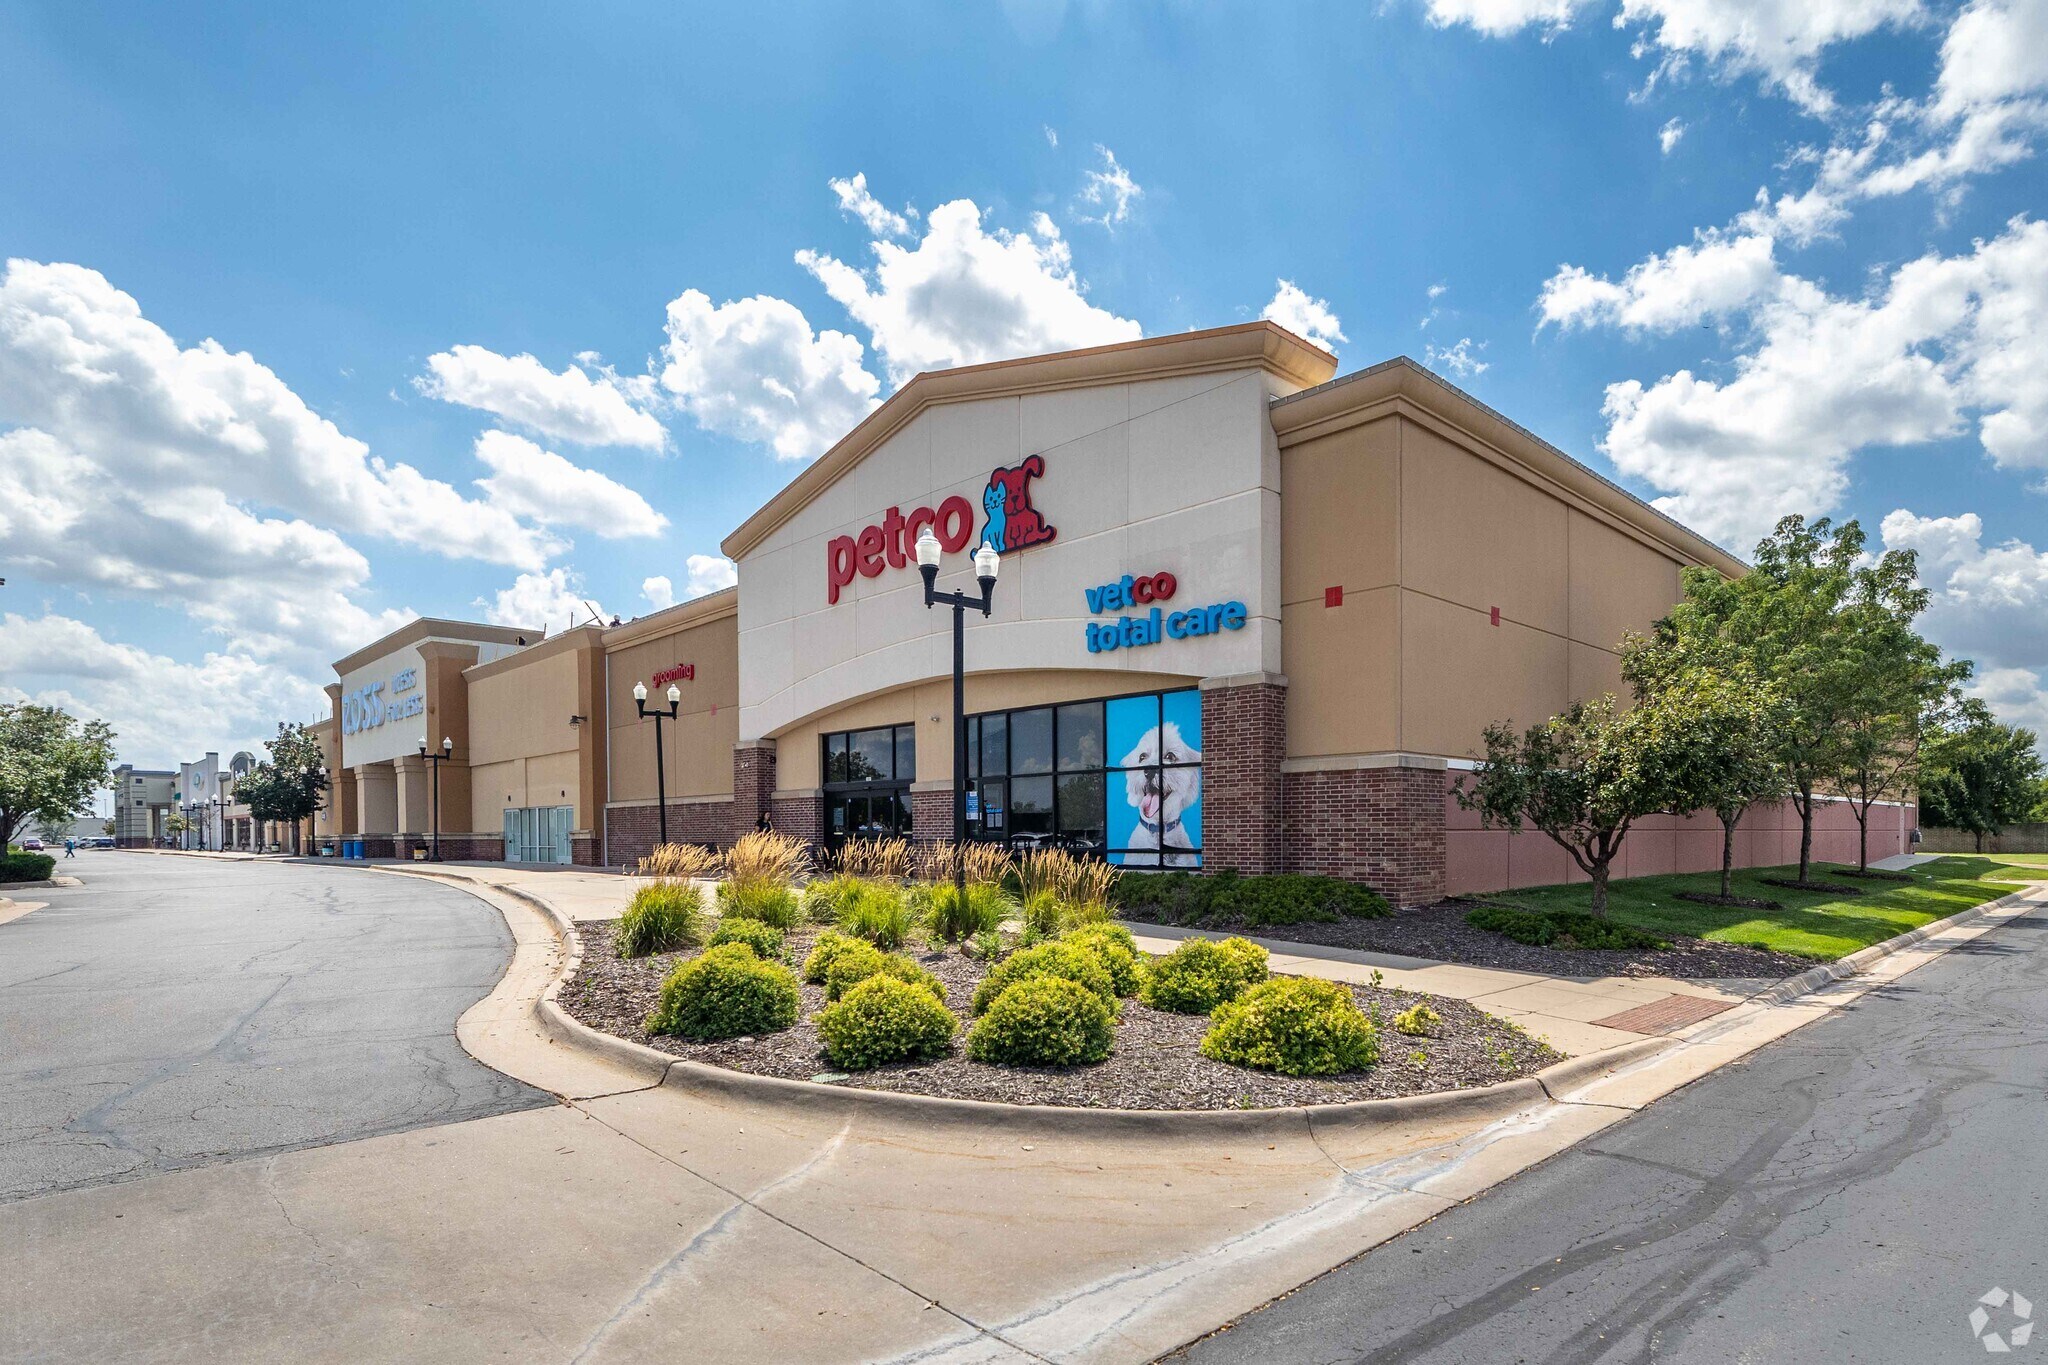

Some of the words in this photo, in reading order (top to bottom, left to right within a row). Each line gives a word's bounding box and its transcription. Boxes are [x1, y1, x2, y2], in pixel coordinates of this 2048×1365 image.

[828, 495, 974, 605] petco
[1085, 571, 1177, 614] vetco
[1085, 607, 1161, 653] total
[1166, 601, 1247, 640] care
[652, 663, 695, 688] grooming
